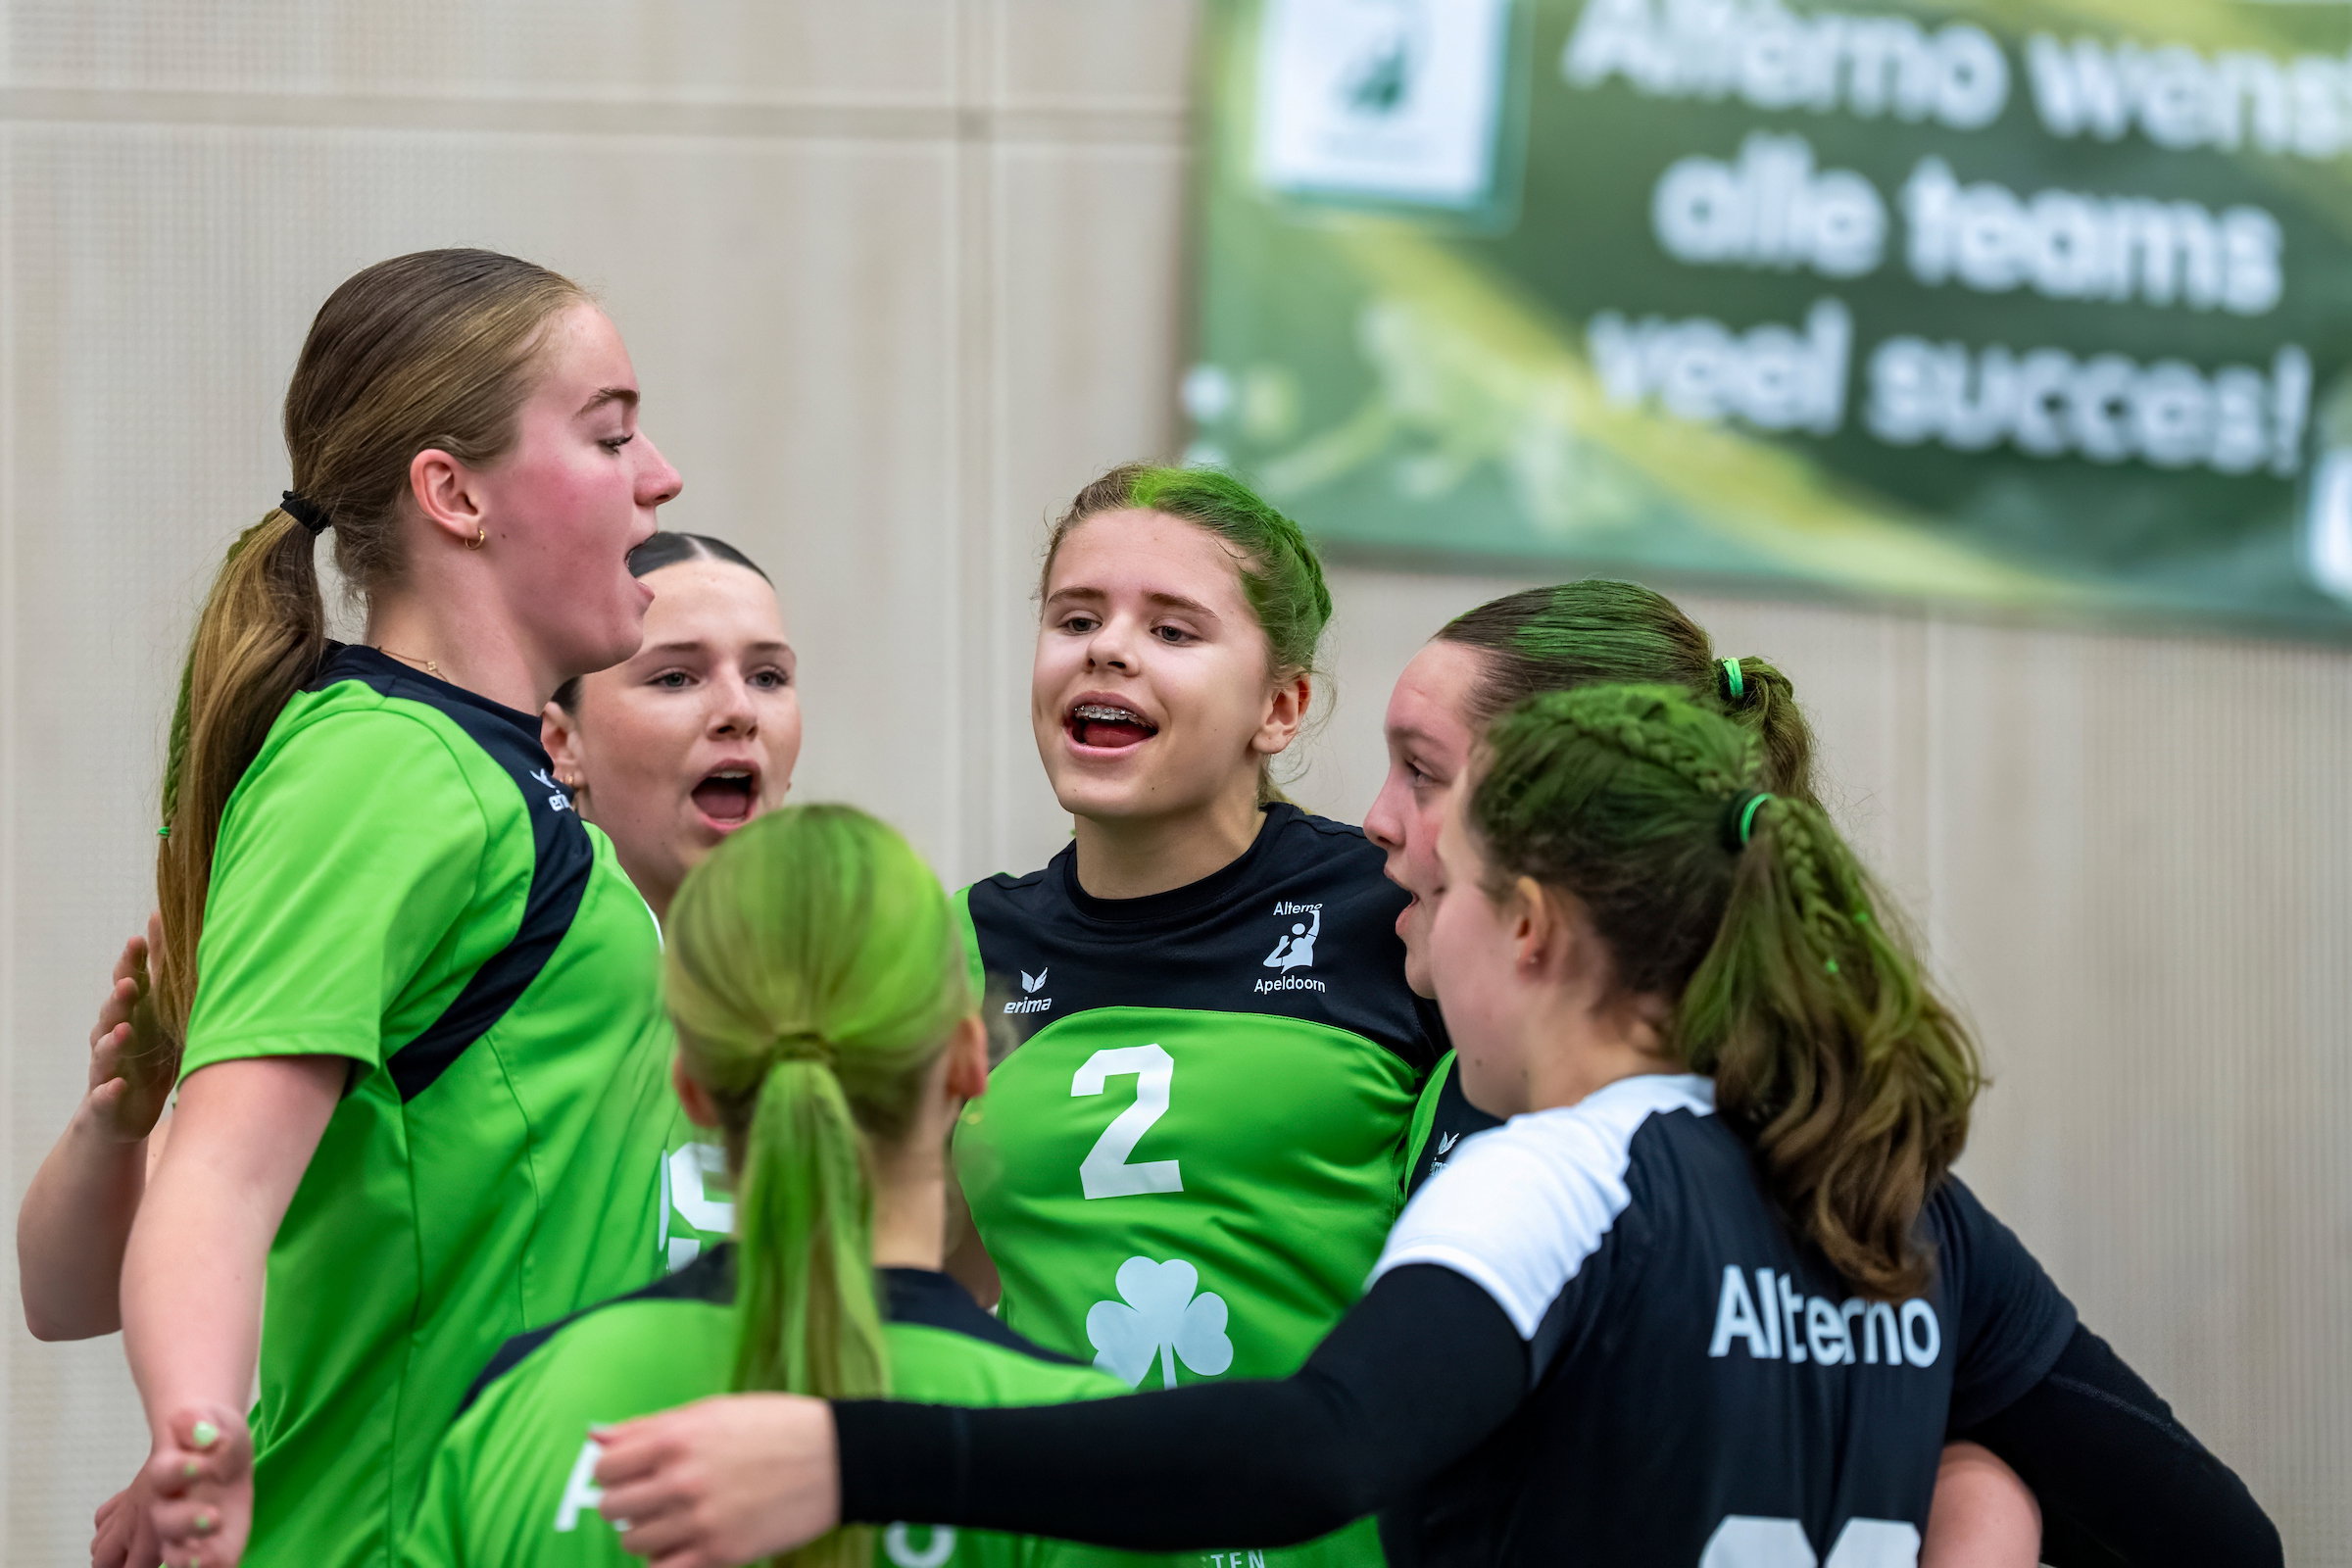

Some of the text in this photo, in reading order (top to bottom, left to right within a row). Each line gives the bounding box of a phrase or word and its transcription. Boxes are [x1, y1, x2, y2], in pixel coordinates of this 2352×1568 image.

[1562, 0, 2352, 159] Alterno wens
[1651, 131, 2283, 315] alle teams
[1588, 298, 2314, 478] veel succes!
[1273, 902, 1323, 915] Alterno
[1003, 996, 1053, 1013] erima
[1253, 975, 1326, 995] Apeldoorn
[1070, 1044, 1184, 1200] 2
[1708, 1264, 1941, 1368] Alterno
